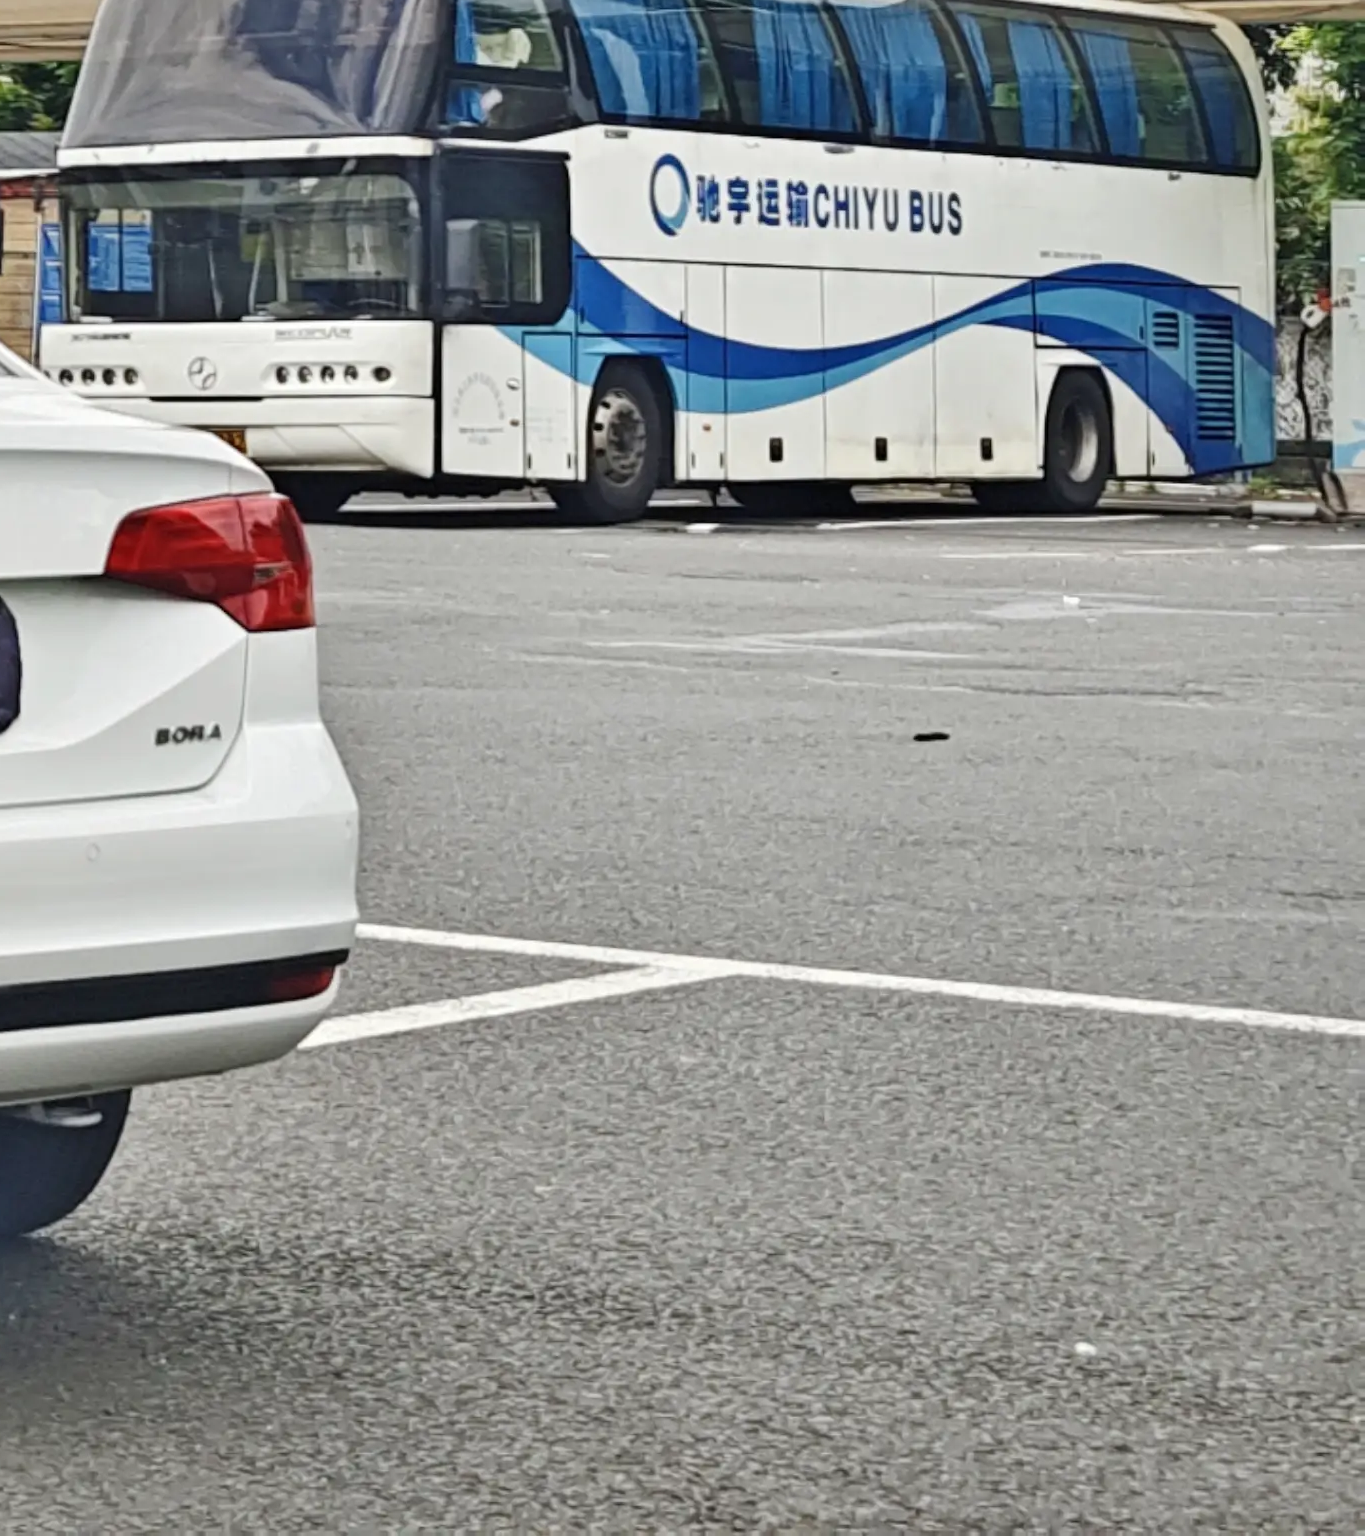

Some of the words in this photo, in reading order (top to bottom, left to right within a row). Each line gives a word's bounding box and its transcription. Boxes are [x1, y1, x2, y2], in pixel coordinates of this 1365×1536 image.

[695, 174, 809, 228] 驰宇运输
[812, 183, 899, 233] CHIYU
[909, 190, 963, 236] BUS
[155, 723, 222, 746] BORA
